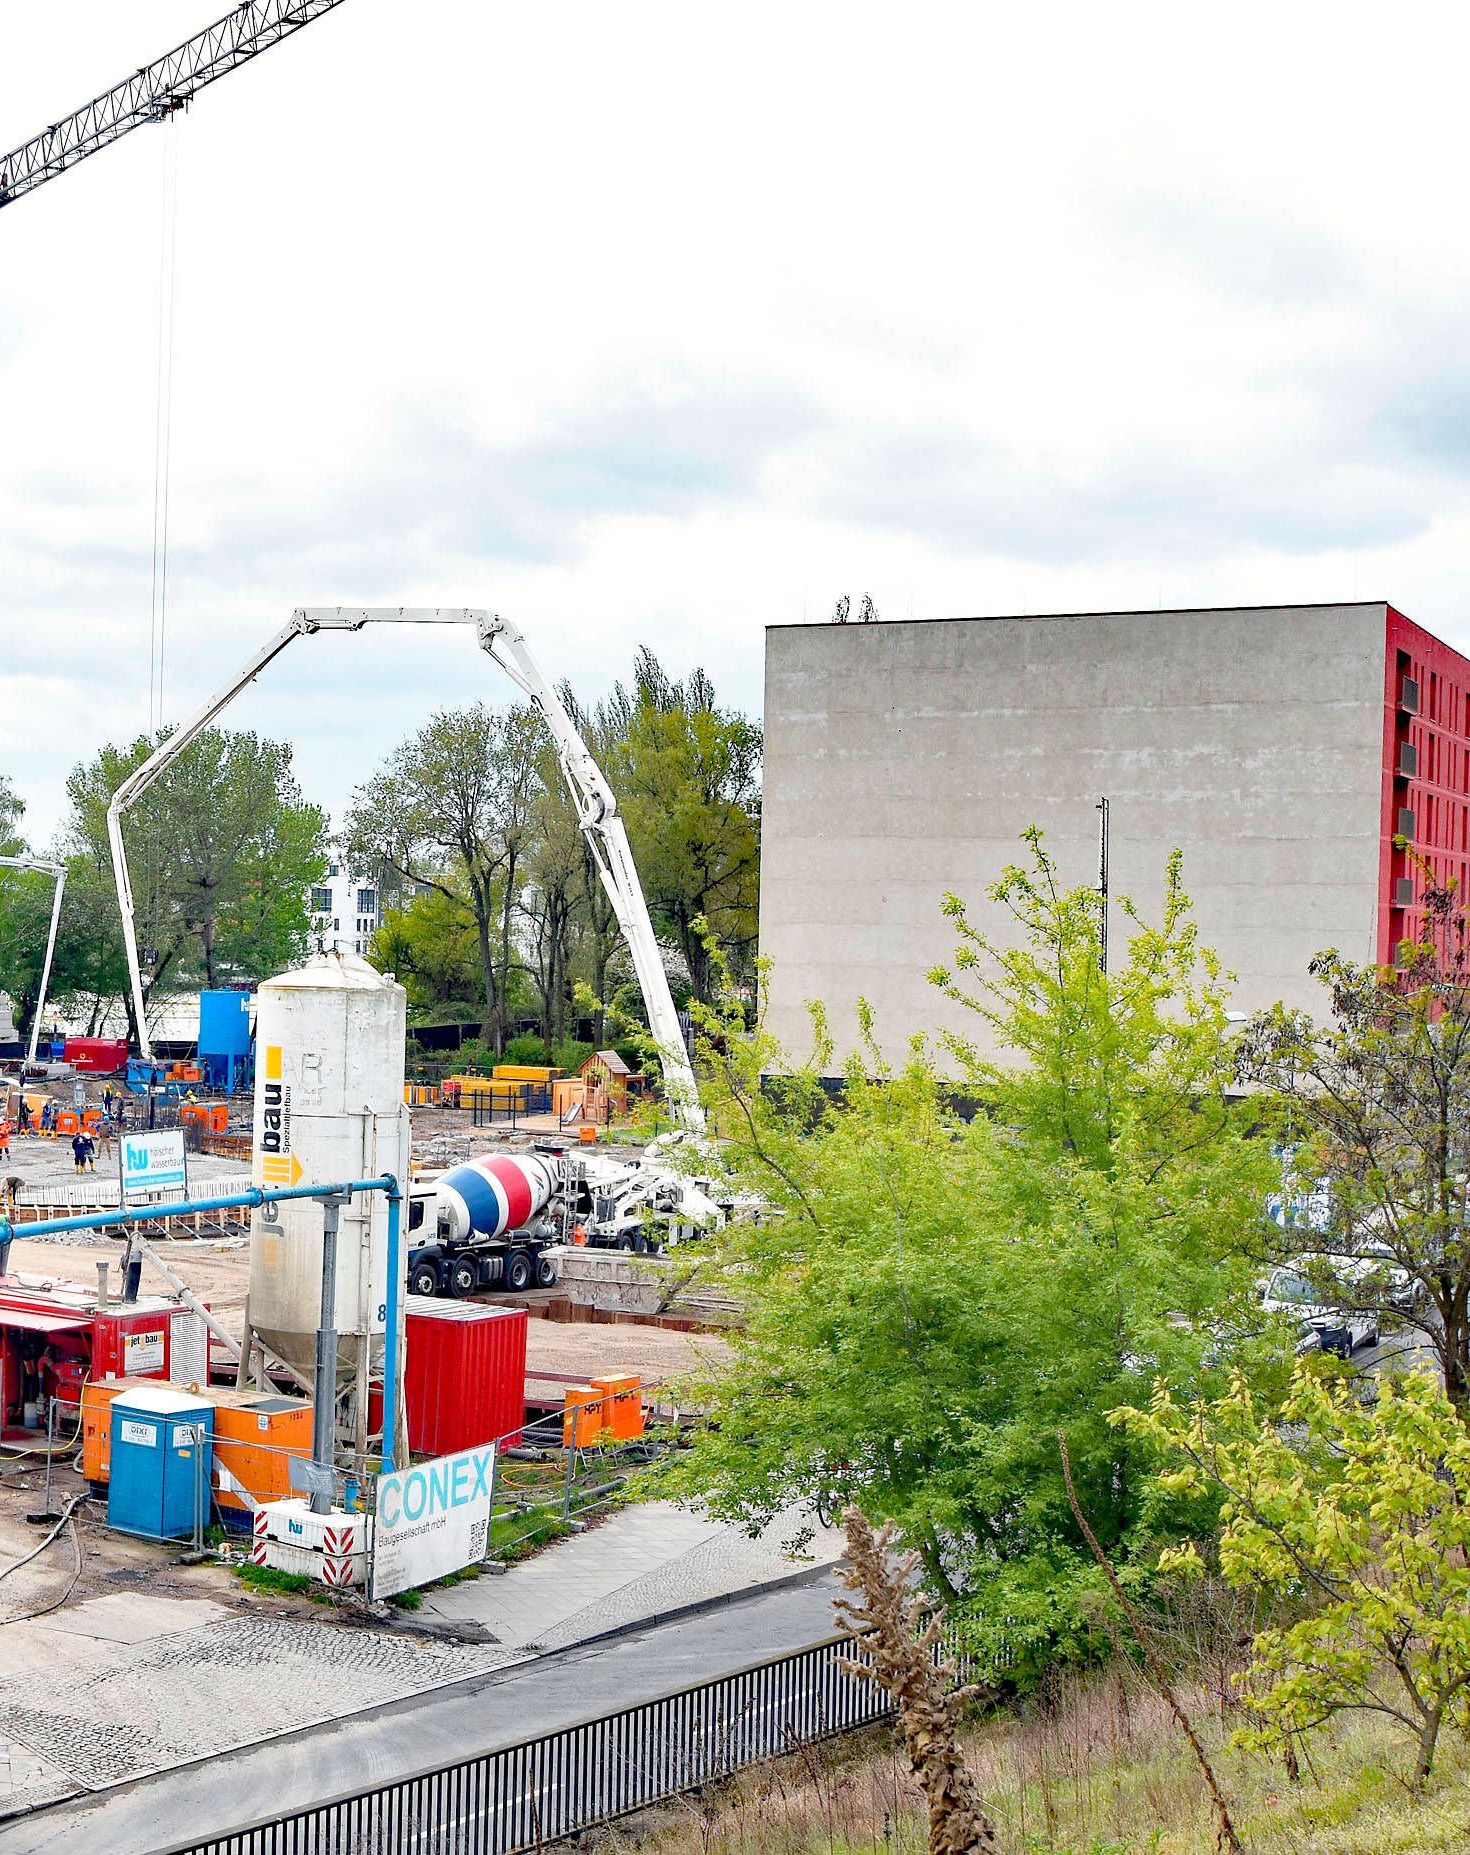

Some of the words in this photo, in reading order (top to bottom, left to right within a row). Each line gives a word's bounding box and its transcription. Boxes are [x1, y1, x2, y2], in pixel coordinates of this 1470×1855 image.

[260, 1084, 282, 1153] bau
[282, 1086, 292, 1154] Spezialtiefbau
[130, 1336, 140, 1348] jet
[145, 1335, 158, 1344] bau
[380, 1451, 491, 1529] CONEX
[378, 1519, 430, 1548] Baugesellschaft
[430, 1515, 447, 1530] mbH
